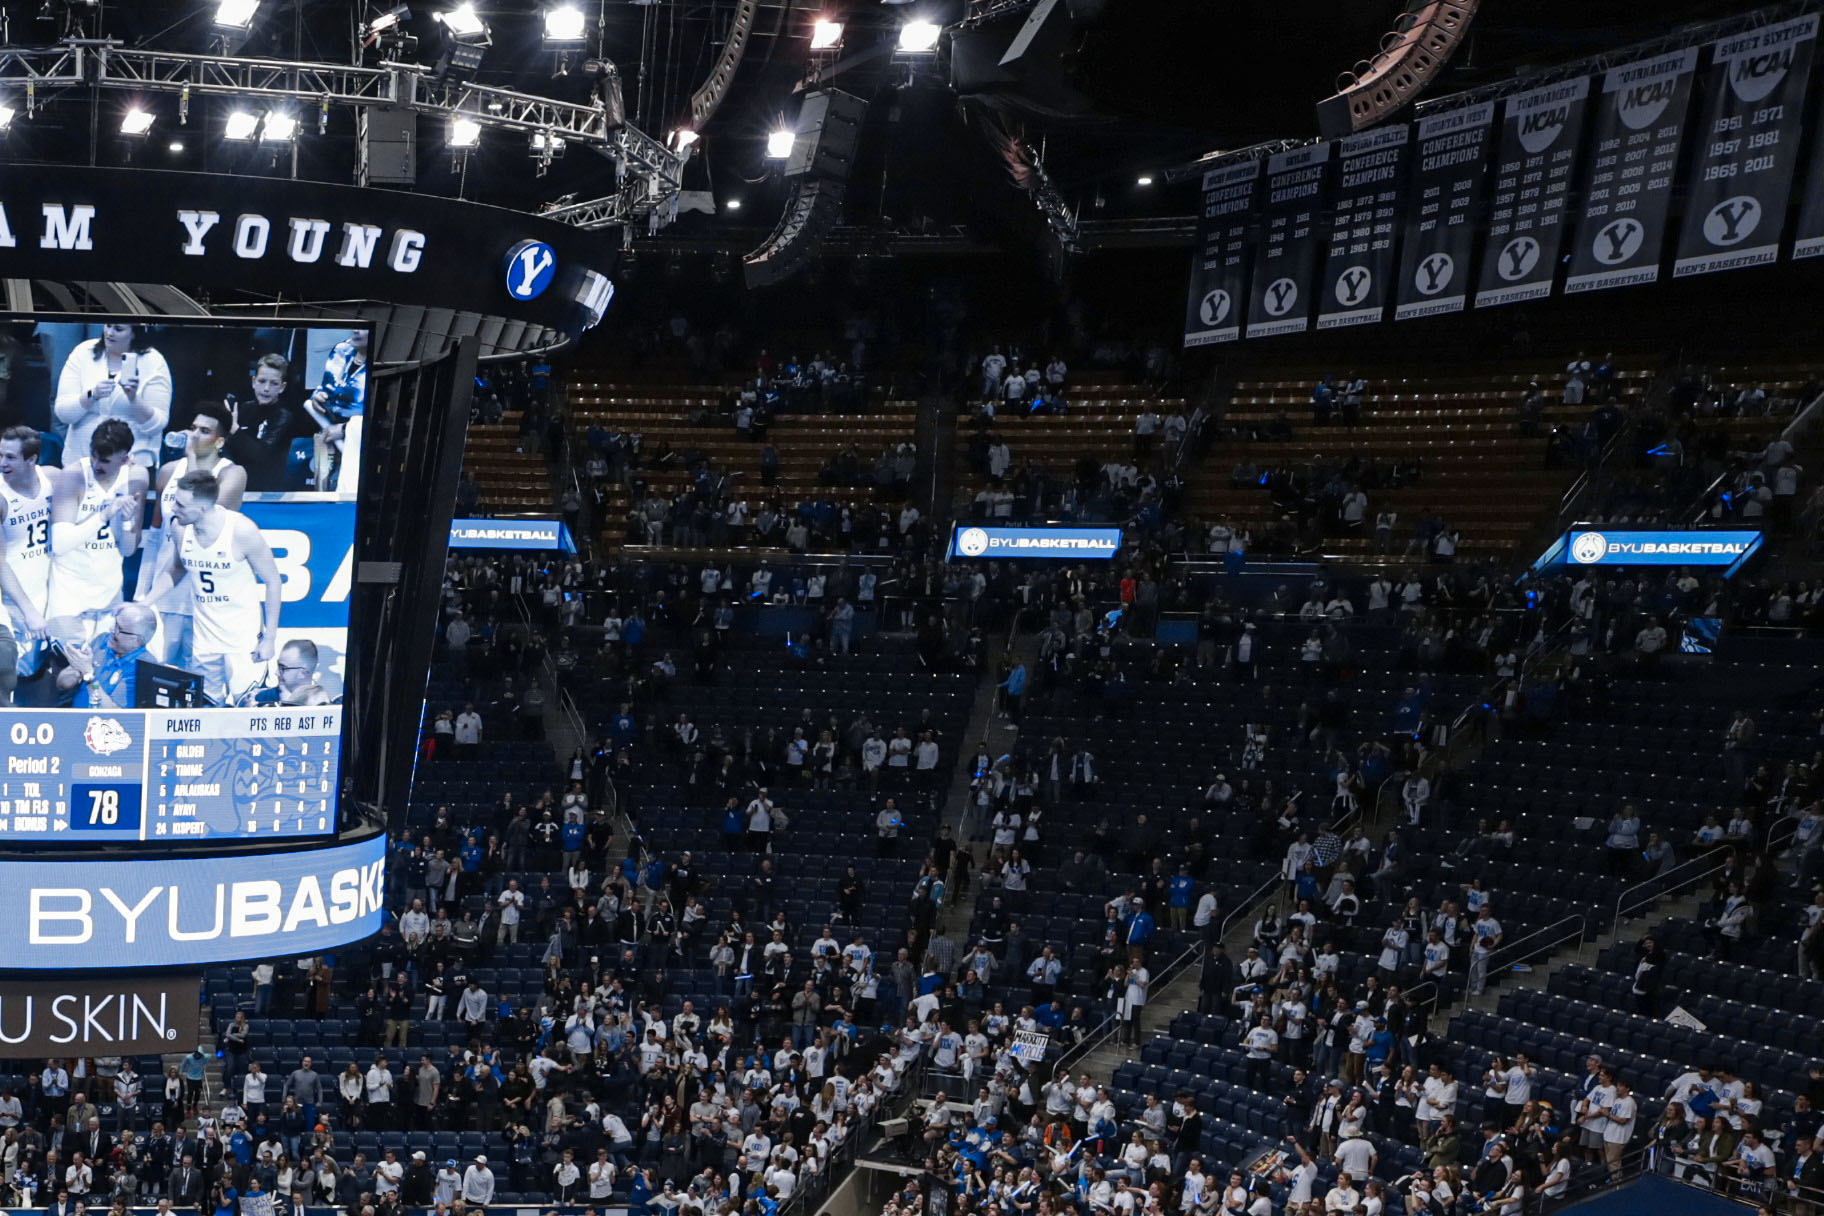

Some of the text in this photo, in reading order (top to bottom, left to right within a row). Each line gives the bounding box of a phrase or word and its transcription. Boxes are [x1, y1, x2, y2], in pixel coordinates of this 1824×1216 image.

[1736, 48, 1793, 82] NCAA
[1623, 80, 1675, 110] NCAA
[1523, 106, 1569, 135] NCAA
[1714, 105, 1783, 132] 1951 1971
[1423, 129, 1484, 155] CONFERENCE
[1709, 130, 1779, 157] 1957 1981
[1423, 147, 1479, 171] CHAMPIONS
[1704, 155, 1774, 180] 1965 2011
[1716, 201, 1753, 240] Y
[177, 209, 426, 273] YOUNG
[516, 246, 553, 297] Y
[1676, 251, 1774, 275] MEN'S BASKETBALL
[1567, 272, 1656, 292] MEN'S BASKETBALL
[1502, 287, 1549, 302] BASKETBALL
[1419, 301, 1462, 314] BASKETBALL
[10, 507, 52, 526] BRIGHA
[26, 519, 49, 549] 13
[179, 558, 231, 570] BRIGHAM
[200, 571, 215, 593] 5
[10, 723, 54, 745] 0.0
[167, 716, 333, 732] PLAYER PTS REB AST PF
[324, 742, 331, 754] 2
[8, 757, 60, 774] Period 2
[89, 766, 122, 777] GONZAGA
[161, 764, 167, 777] 2
[322, 760, 329, 773] 2
[89, 790, 119, 825] 78
